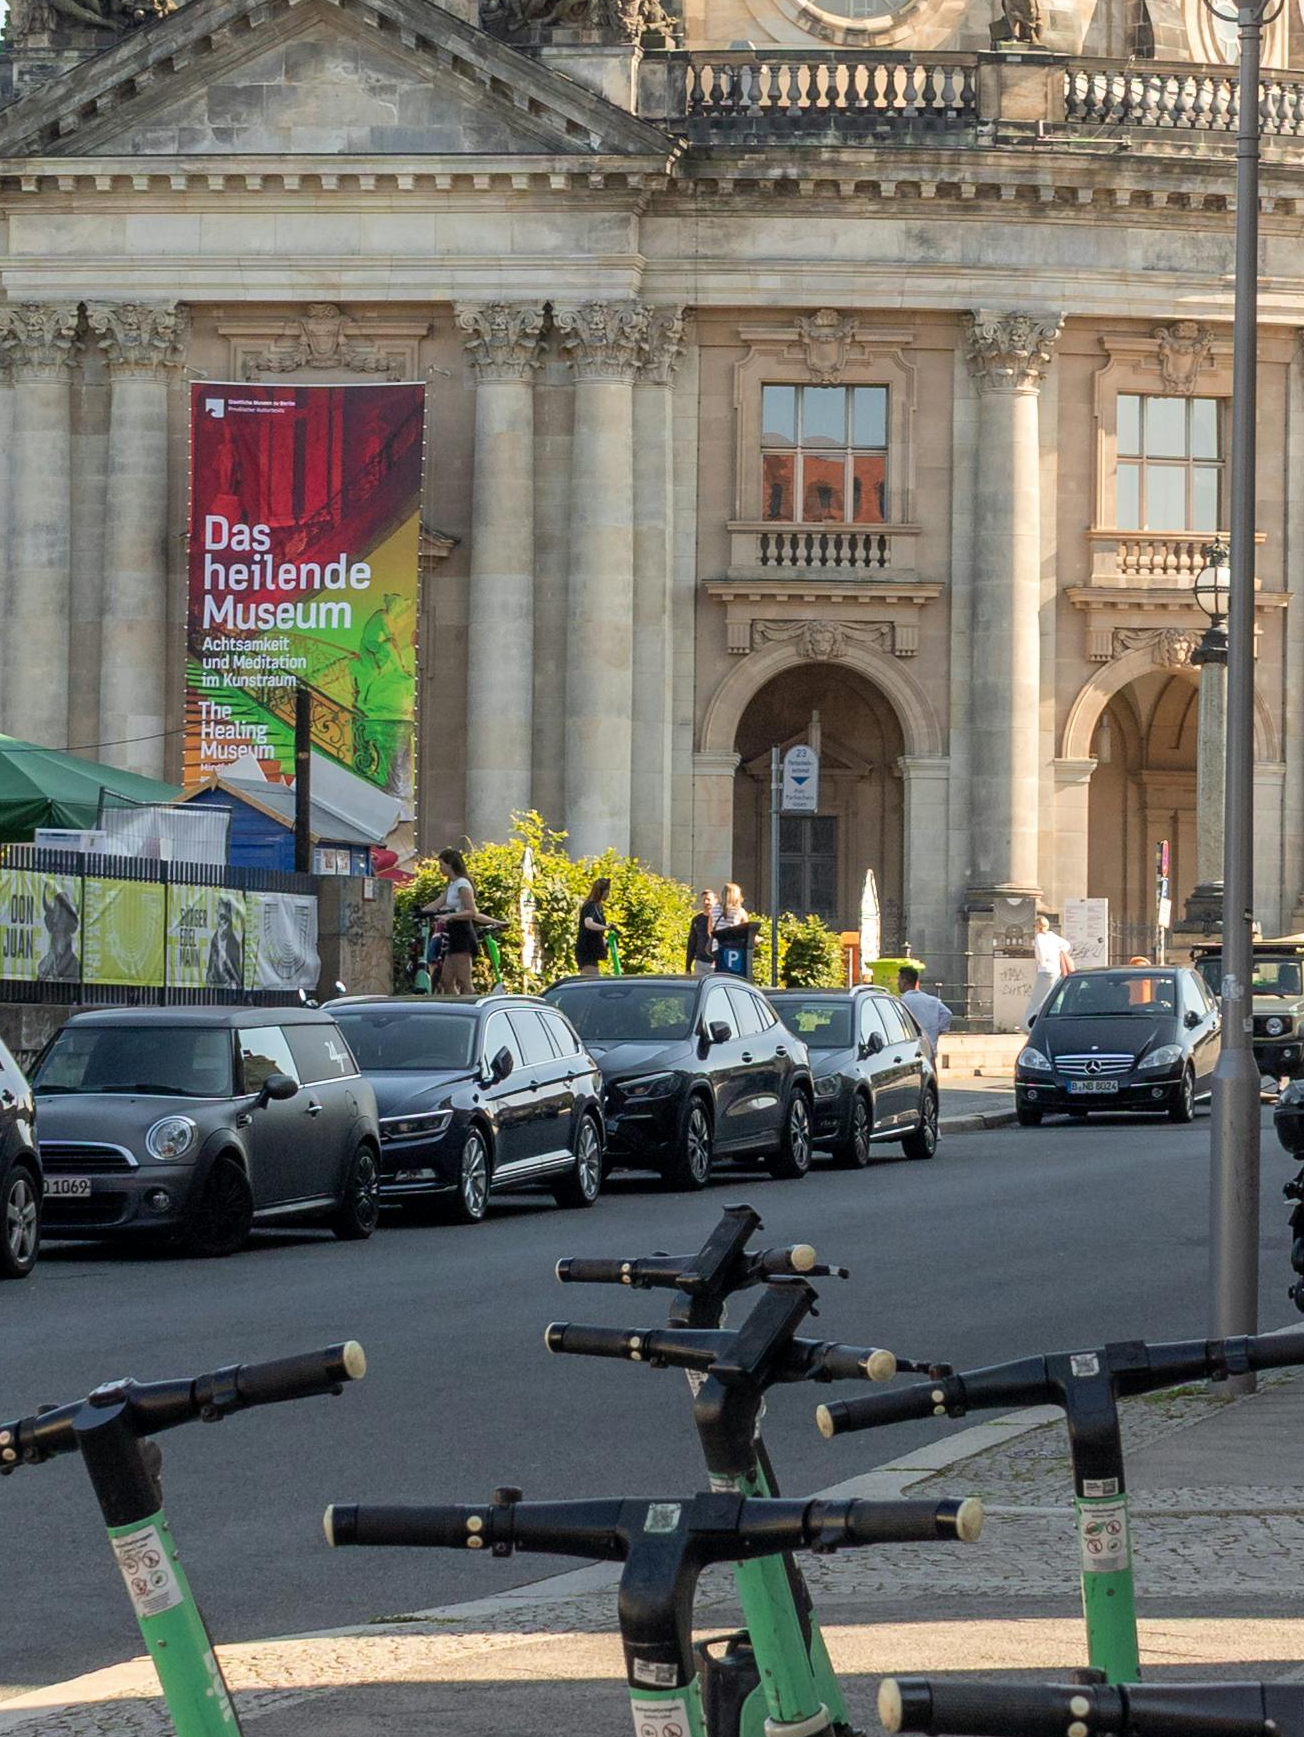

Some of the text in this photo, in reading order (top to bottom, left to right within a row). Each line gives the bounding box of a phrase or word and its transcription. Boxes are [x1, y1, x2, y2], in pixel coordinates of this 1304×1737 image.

[205, 515, 271, 551] Das
[204, 553, 371, 590] heilende
[203, 595, 352, 630] Museum
[202, 636, 290, 651] Achtsamkeit
[202, 655, 307, 669] und Meditation
[201, 672, 297, 687] im Kunstraum
[198, 702, 232, 720] The
[201, 721, 269, 744] Healing
[796, 749, 807, 758] 23
[11, 894, 33, 924] DON
[3, 928, 33, 959] JUAN
[180, 928, 196, 947] EDEL
[728, 951, 739, 967] P
[52, 1179, 88, 1194] 1069
